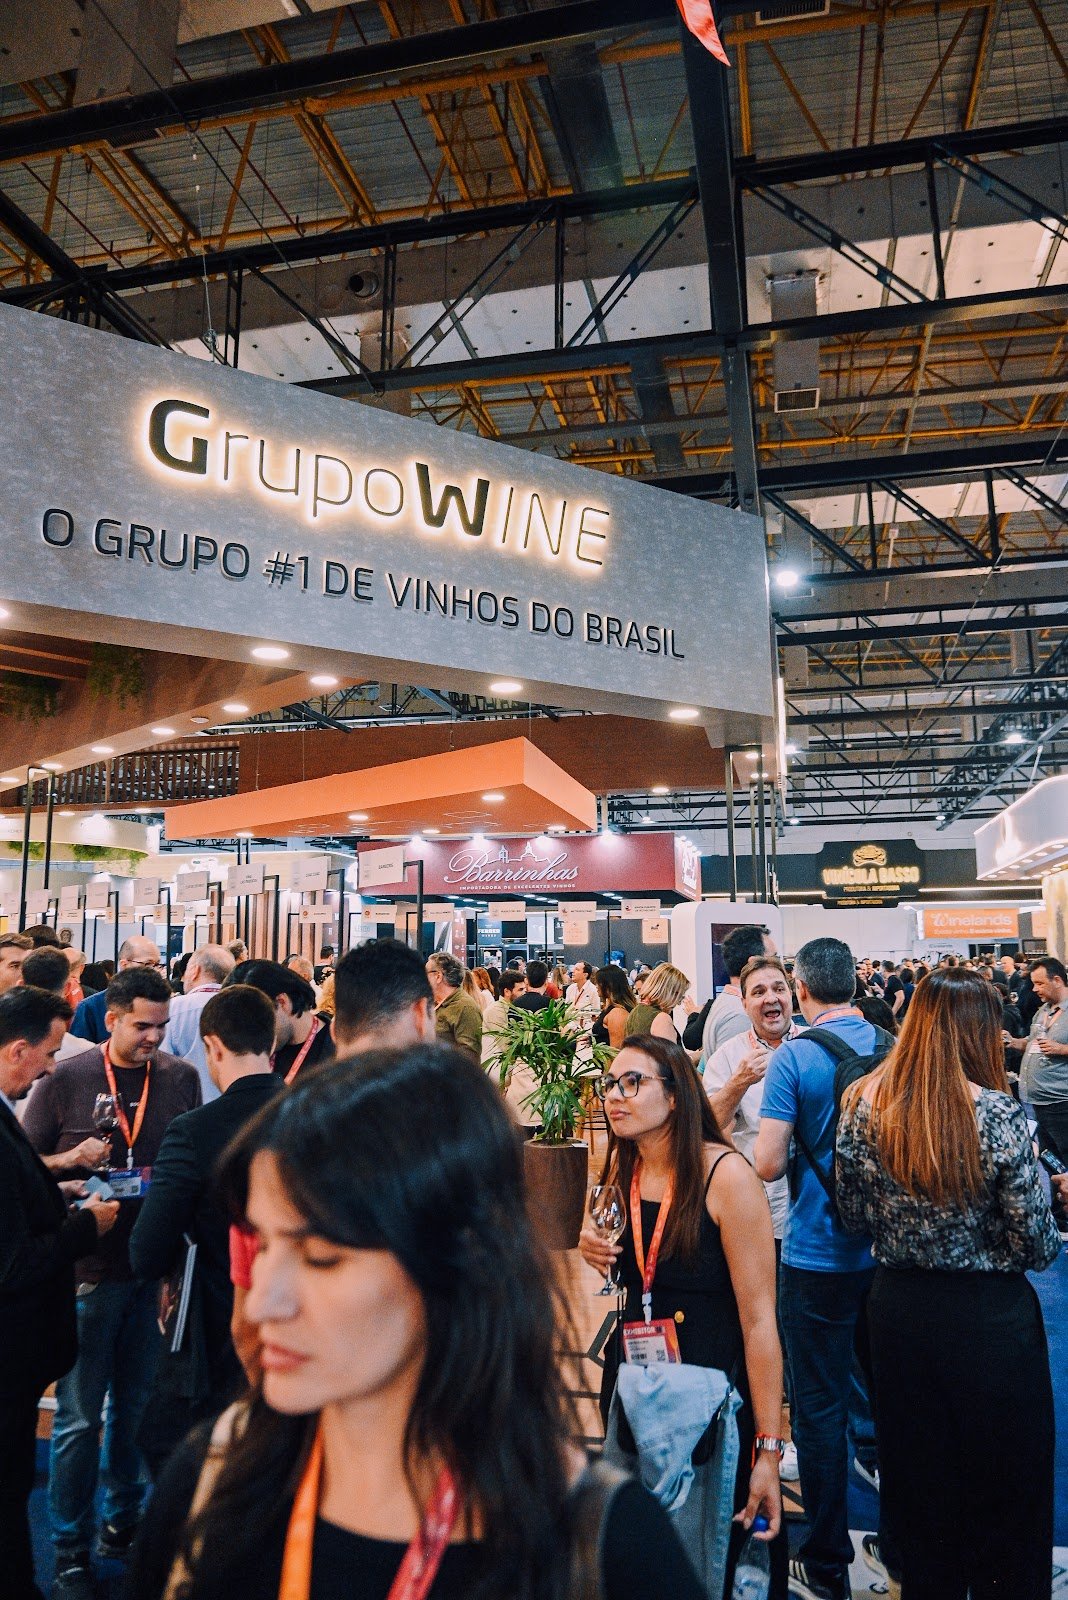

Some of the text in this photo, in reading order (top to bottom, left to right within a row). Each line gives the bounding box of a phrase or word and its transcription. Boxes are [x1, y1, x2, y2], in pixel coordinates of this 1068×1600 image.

[42, 508, 686, 660] O GRUPO #1 DE VINHOS DO BRASIL
[443, 848, 580, 884] Barrinhas
[879, 867, 920, 884] BASSO
